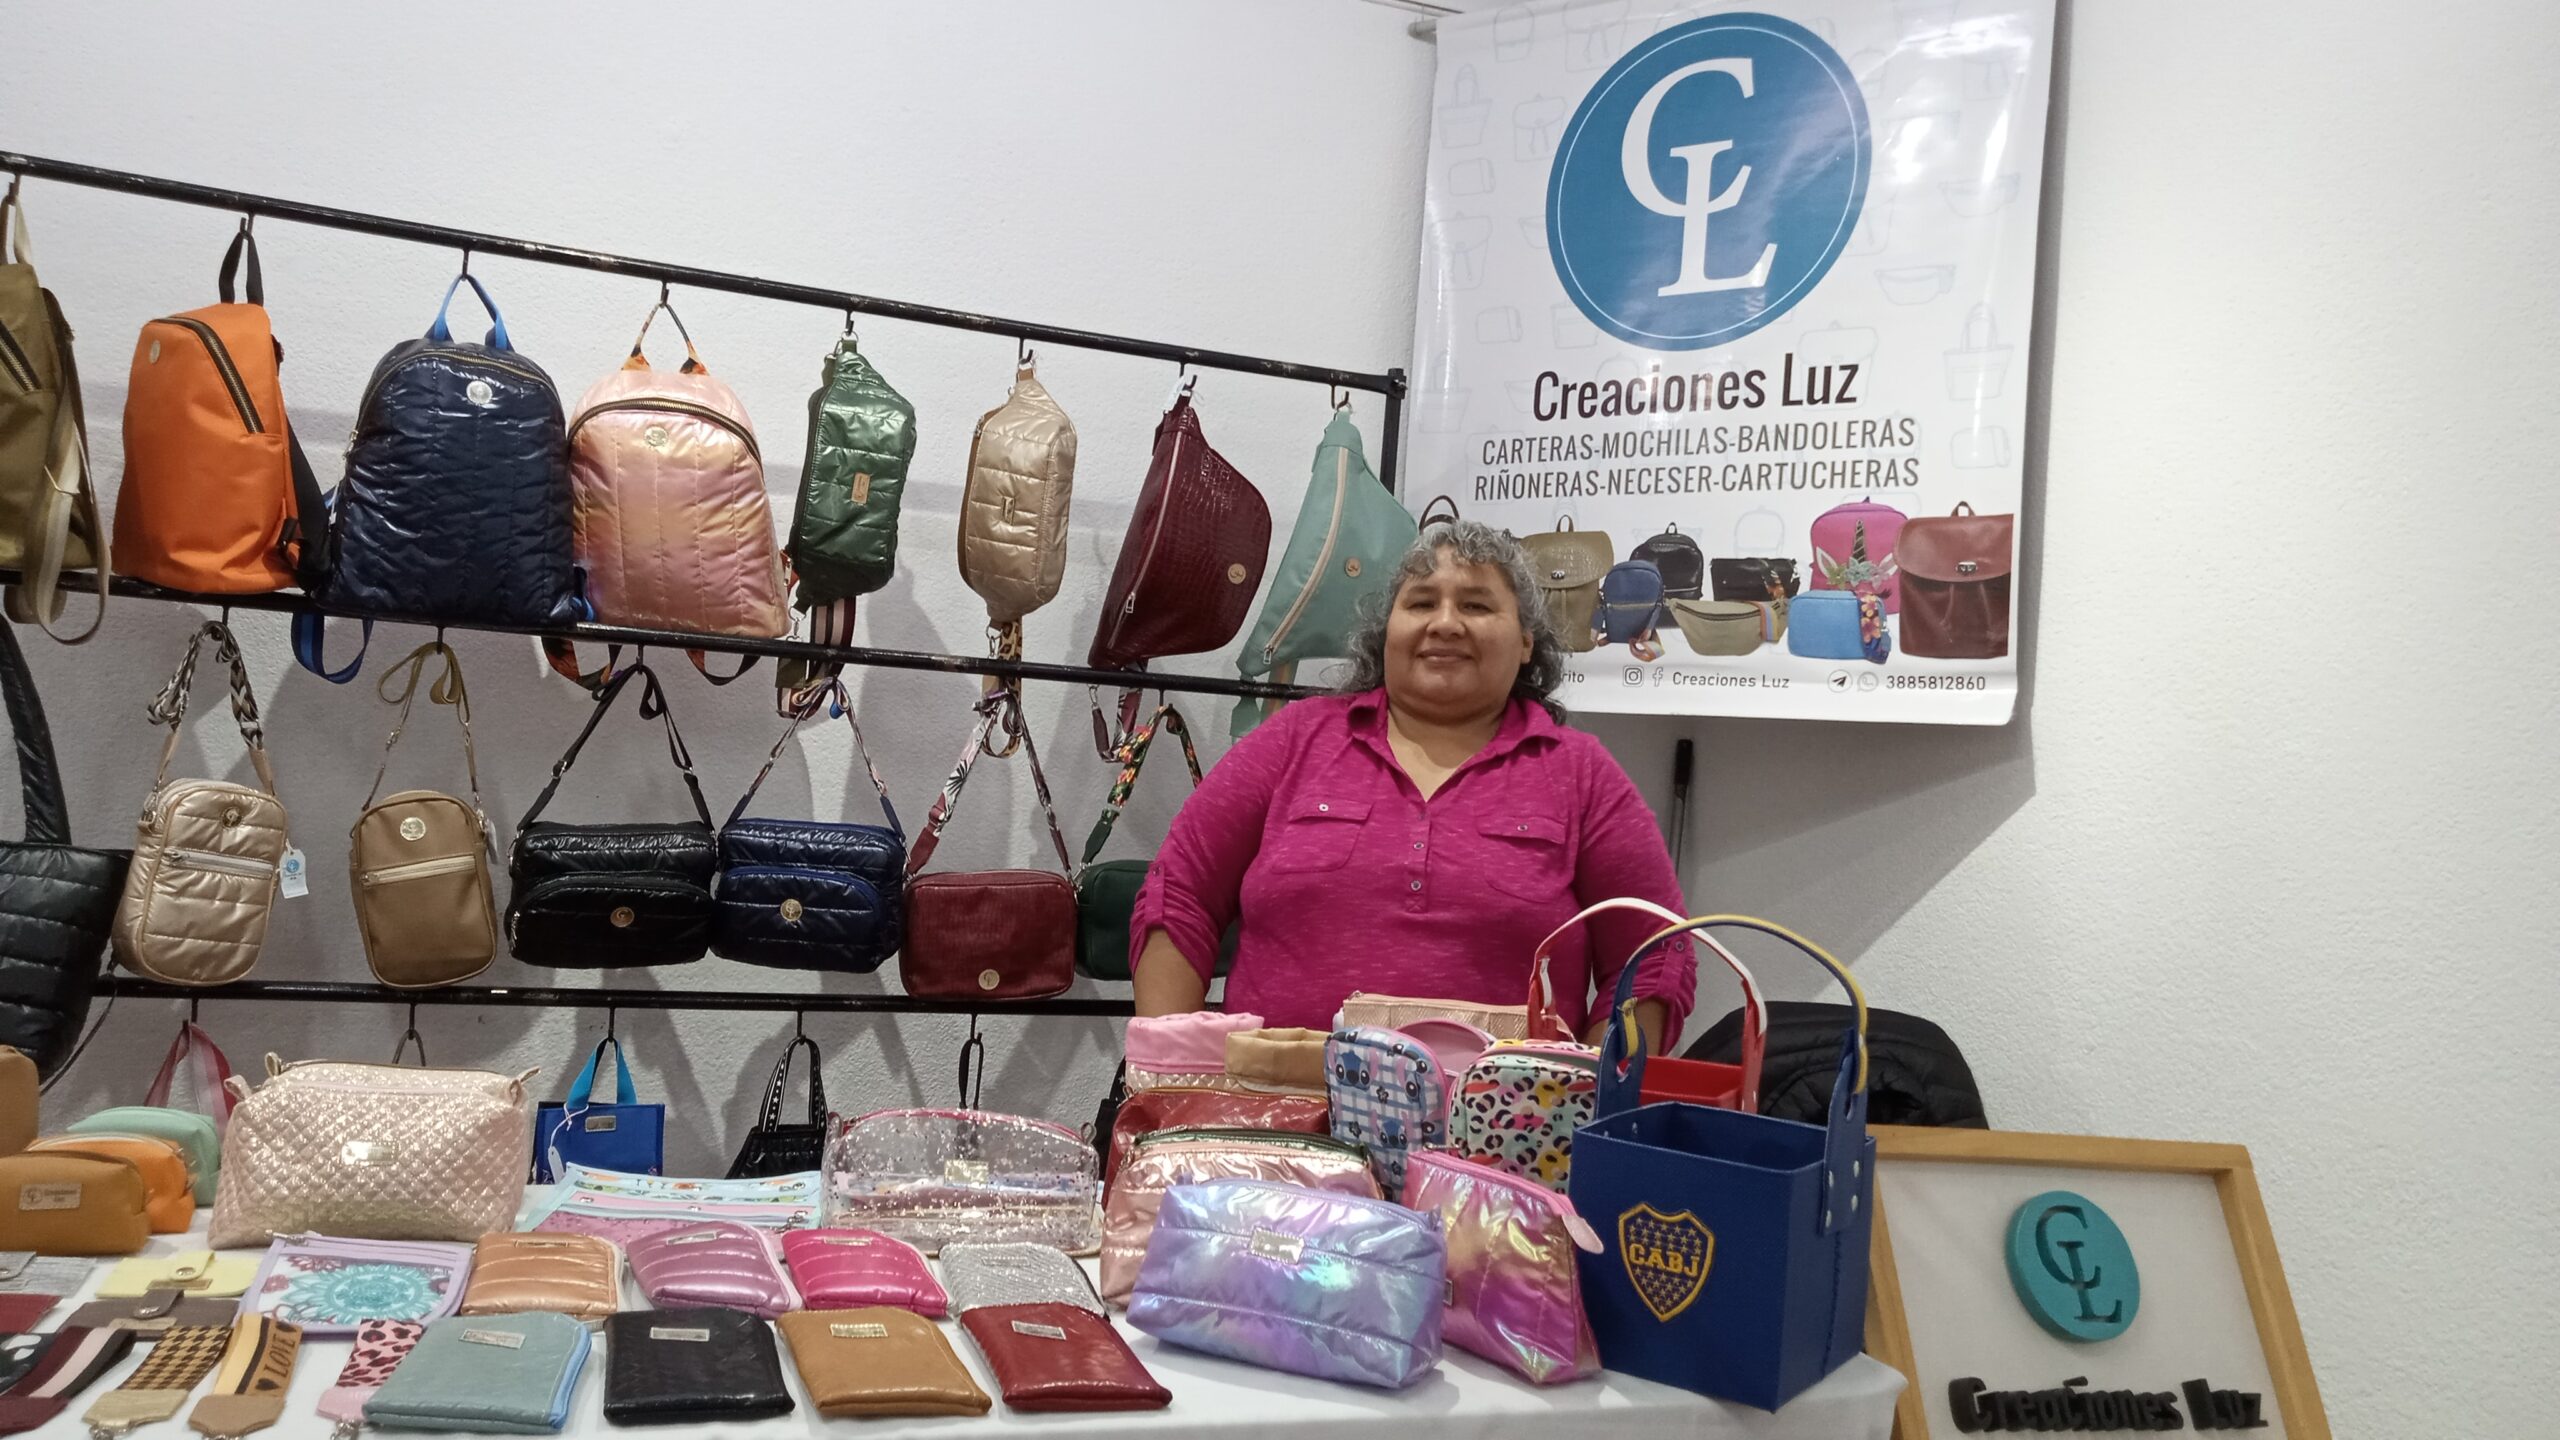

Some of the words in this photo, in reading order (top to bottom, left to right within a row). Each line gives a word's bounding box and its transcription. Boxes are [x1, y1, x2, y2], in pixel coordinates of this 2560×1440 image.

[1533, 364, 1767, 422] Creaciones
[1782, 352, 1859, 407] Luz
[1672, 671, 1757, 688] Creaciones
[1762, 674, 1790, 689] Luz
[1886, 675, 1986, 691] 3885812860
[1629, 1243, 1700, 1278] CABJ
[264, 1332, 296, 1379] LOVE
[1948, 1376, 2184, 1434] Creaciones
[2181, 1378, 2268, 1432] Luz
